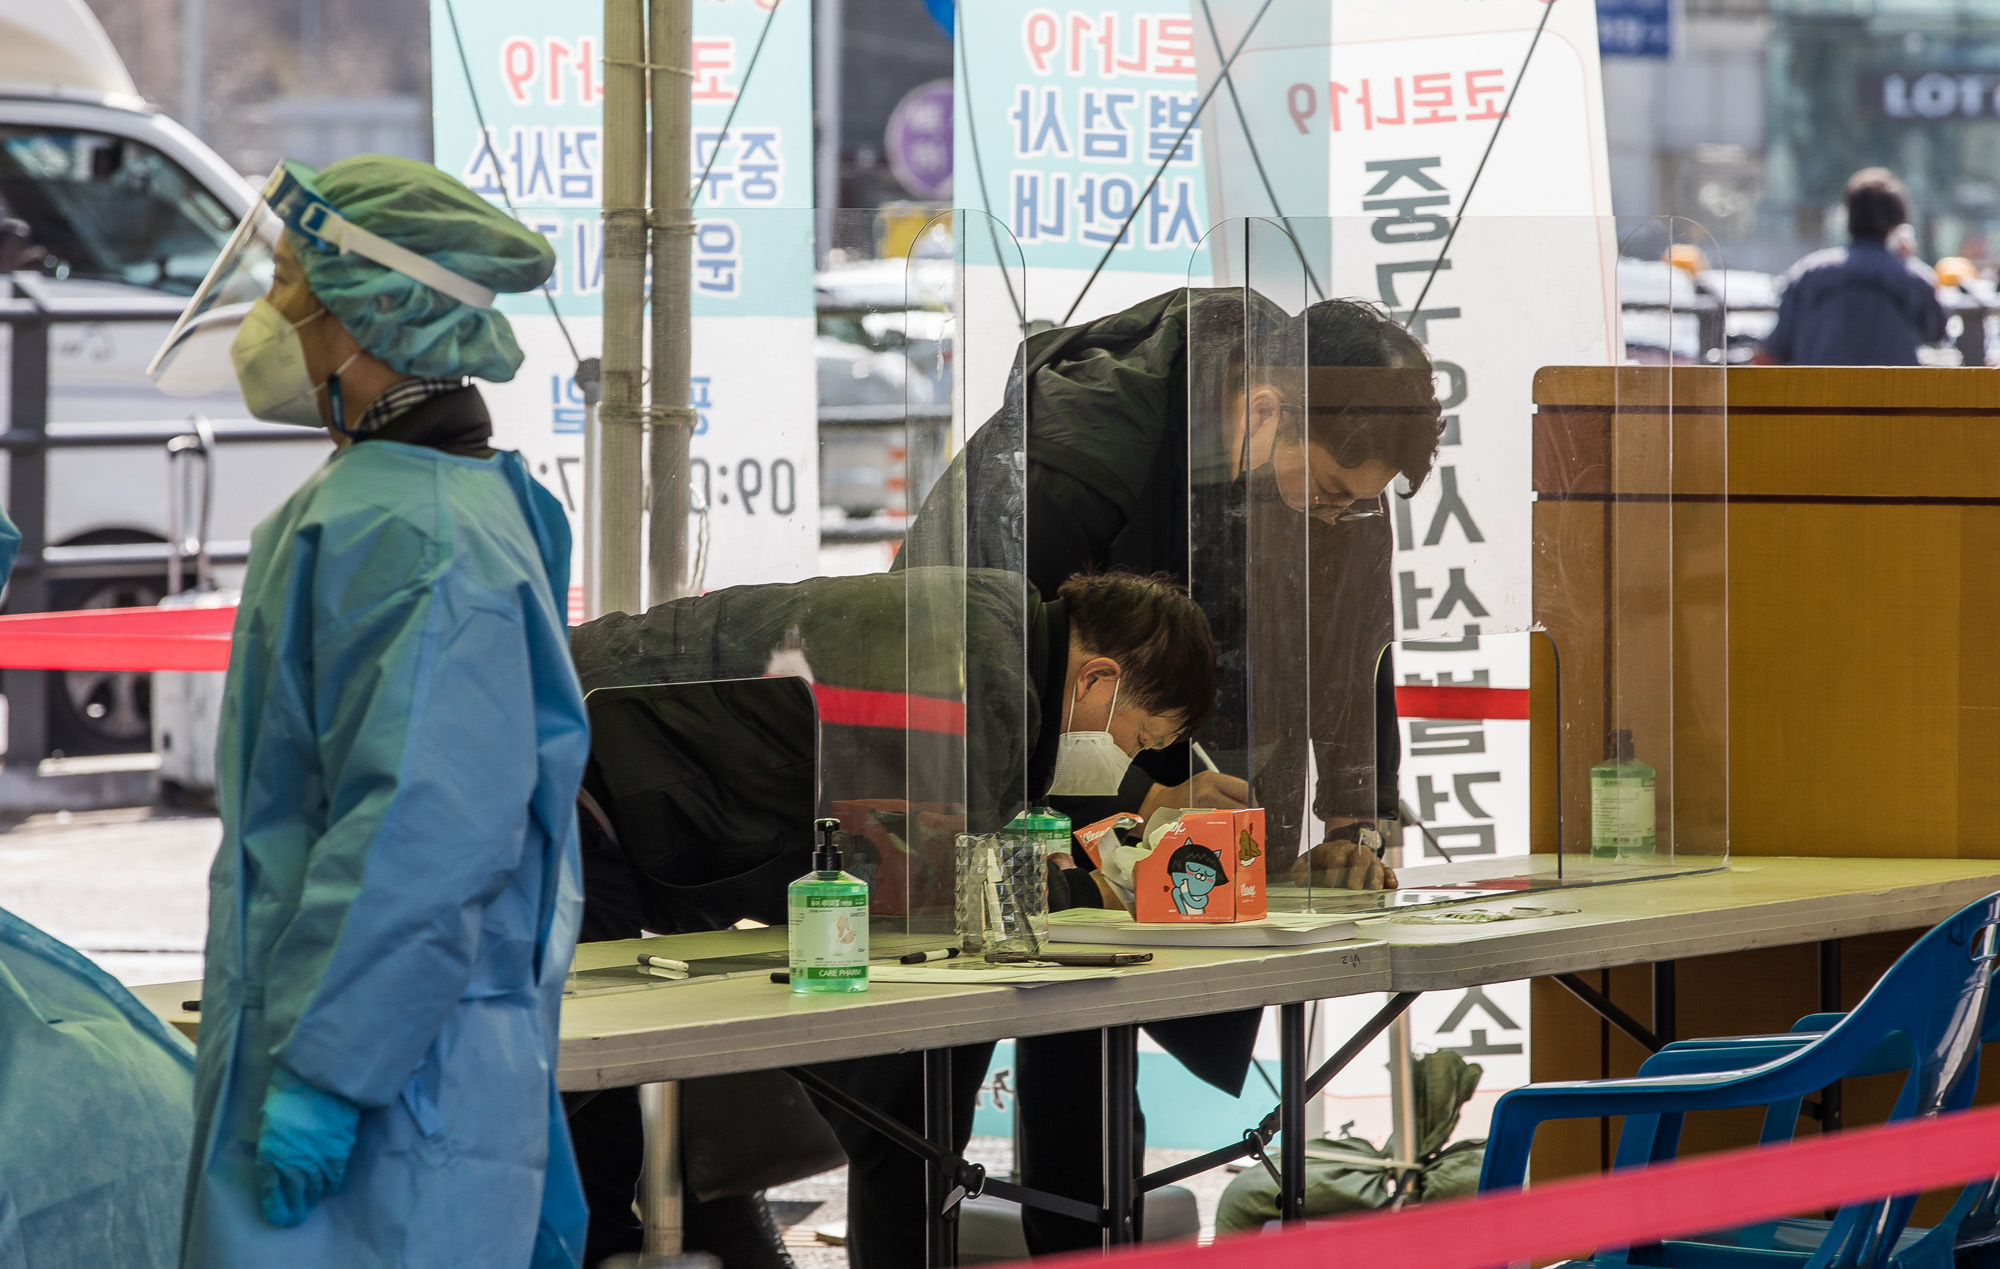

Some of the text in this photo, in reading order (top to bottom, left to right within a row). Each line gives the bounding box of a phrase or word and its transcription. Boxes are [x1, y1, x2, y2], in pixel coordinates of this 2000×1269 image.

[1882, 72, 2000, 118] LOT
[818, 968, 862, 977] CARE PHARM
